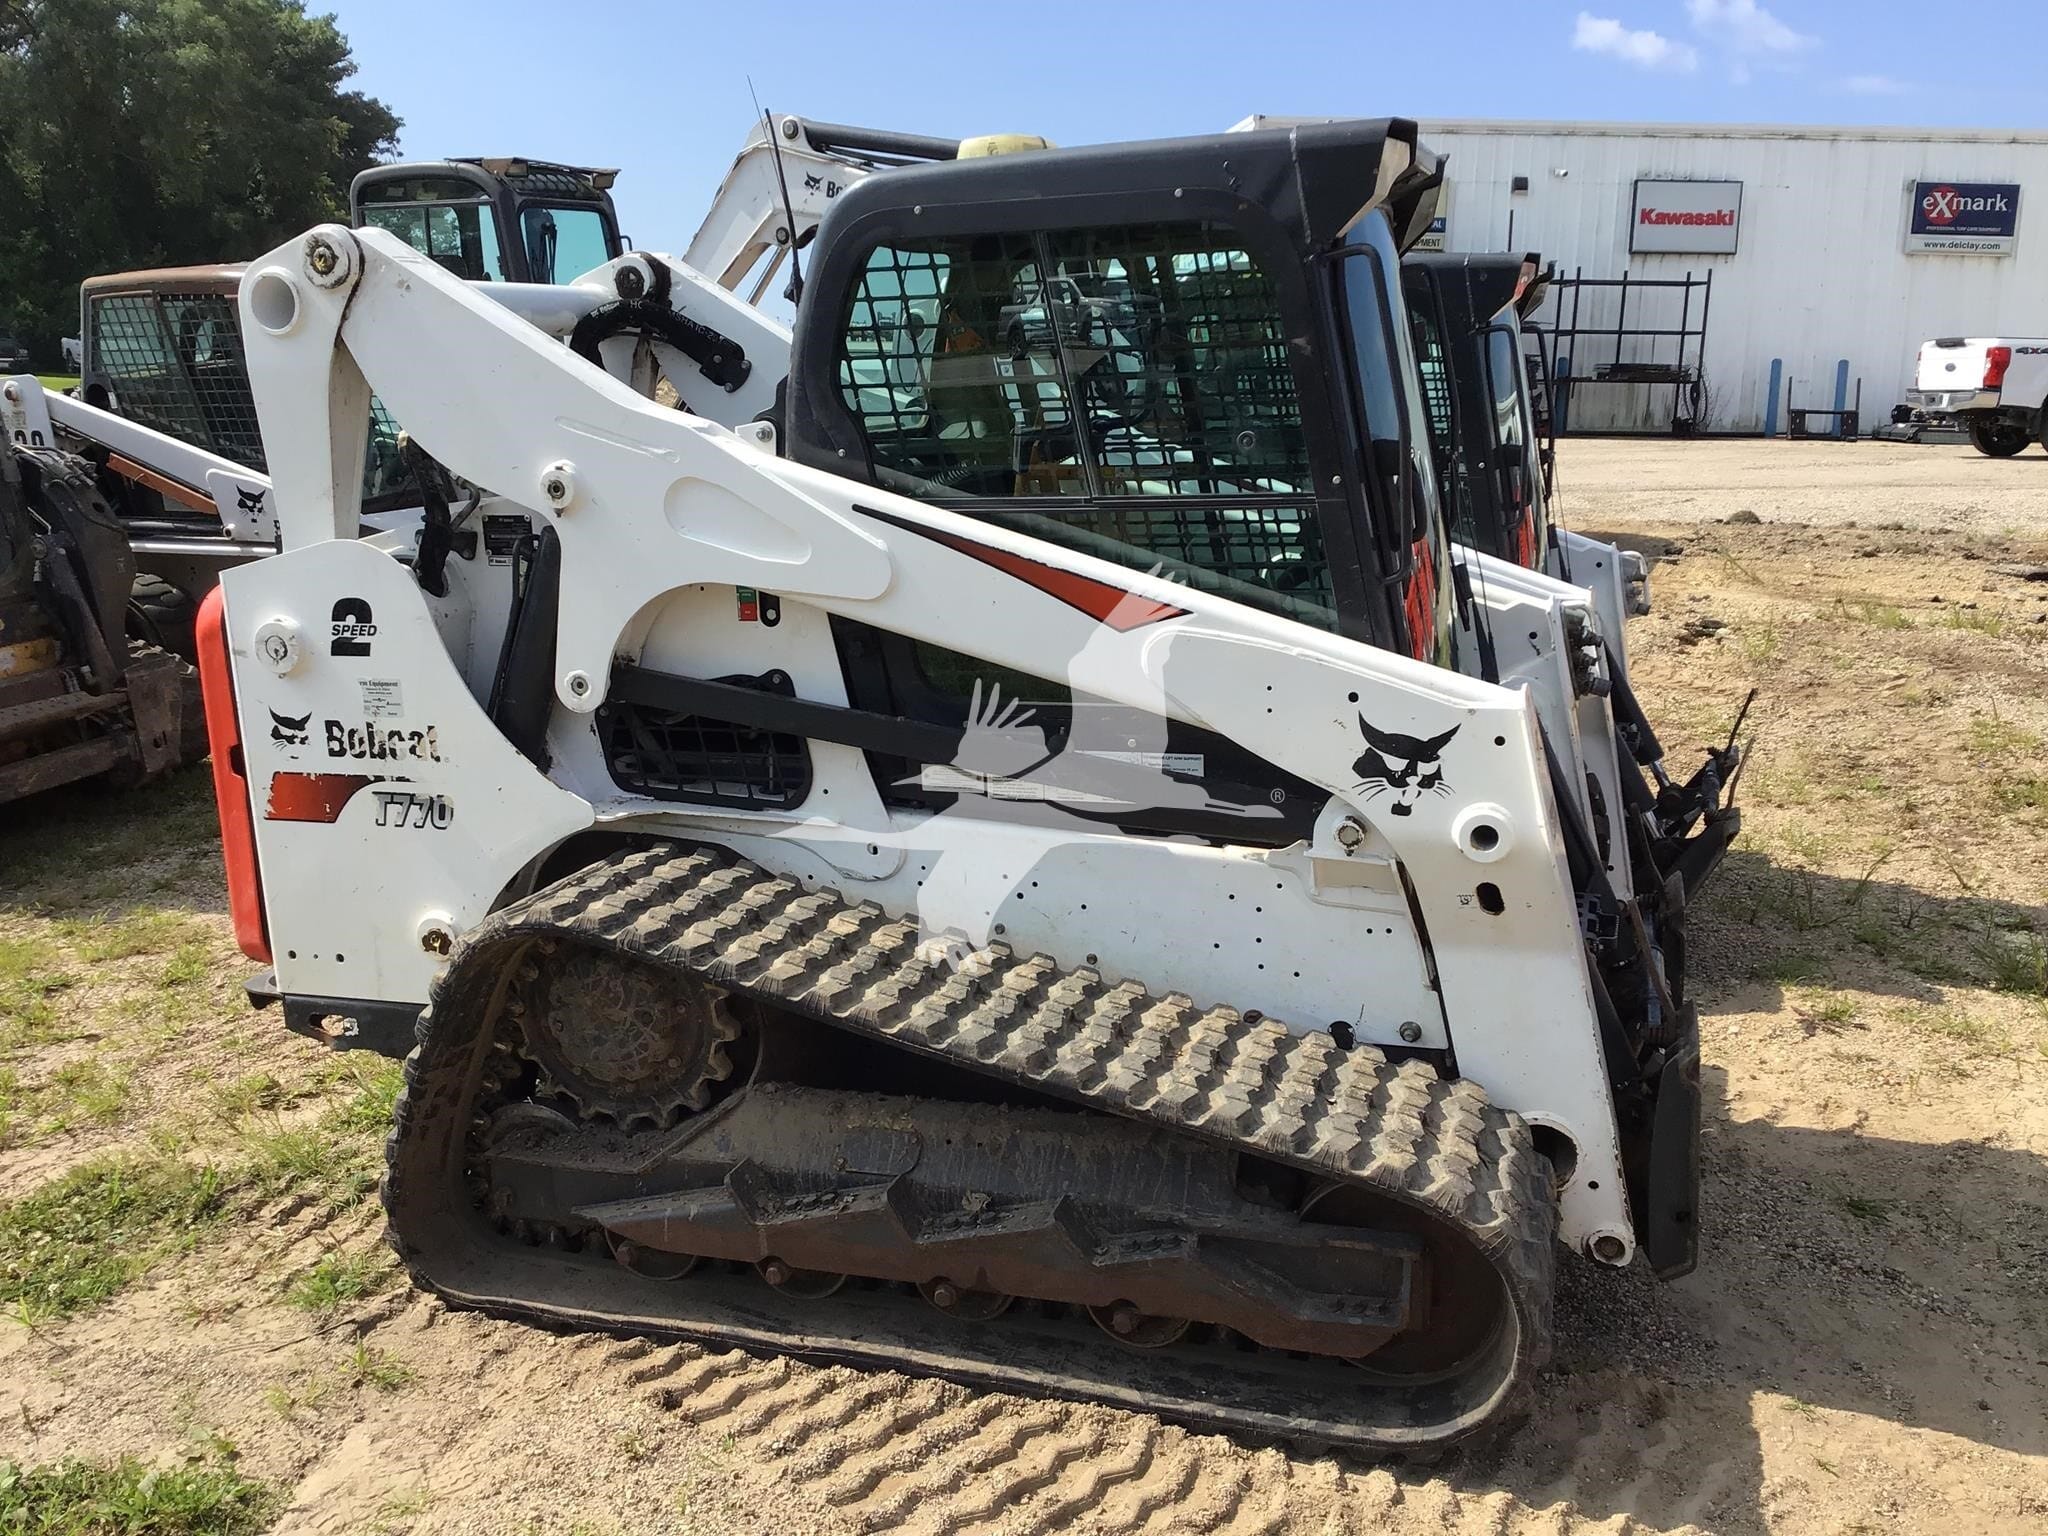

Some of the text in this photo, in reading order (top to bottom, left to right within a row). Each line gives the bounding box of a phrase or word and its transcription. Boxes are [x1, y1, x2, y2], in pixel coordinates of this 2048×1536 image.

[1640, 208, 1735, 226] Kawasaki
[1923, 240, 2001, 252] www.delclay.com
[330, 597, 372, 656] 2
[331, 624, 378, 637] SPEED
[372, 790, 455, 831] T770
